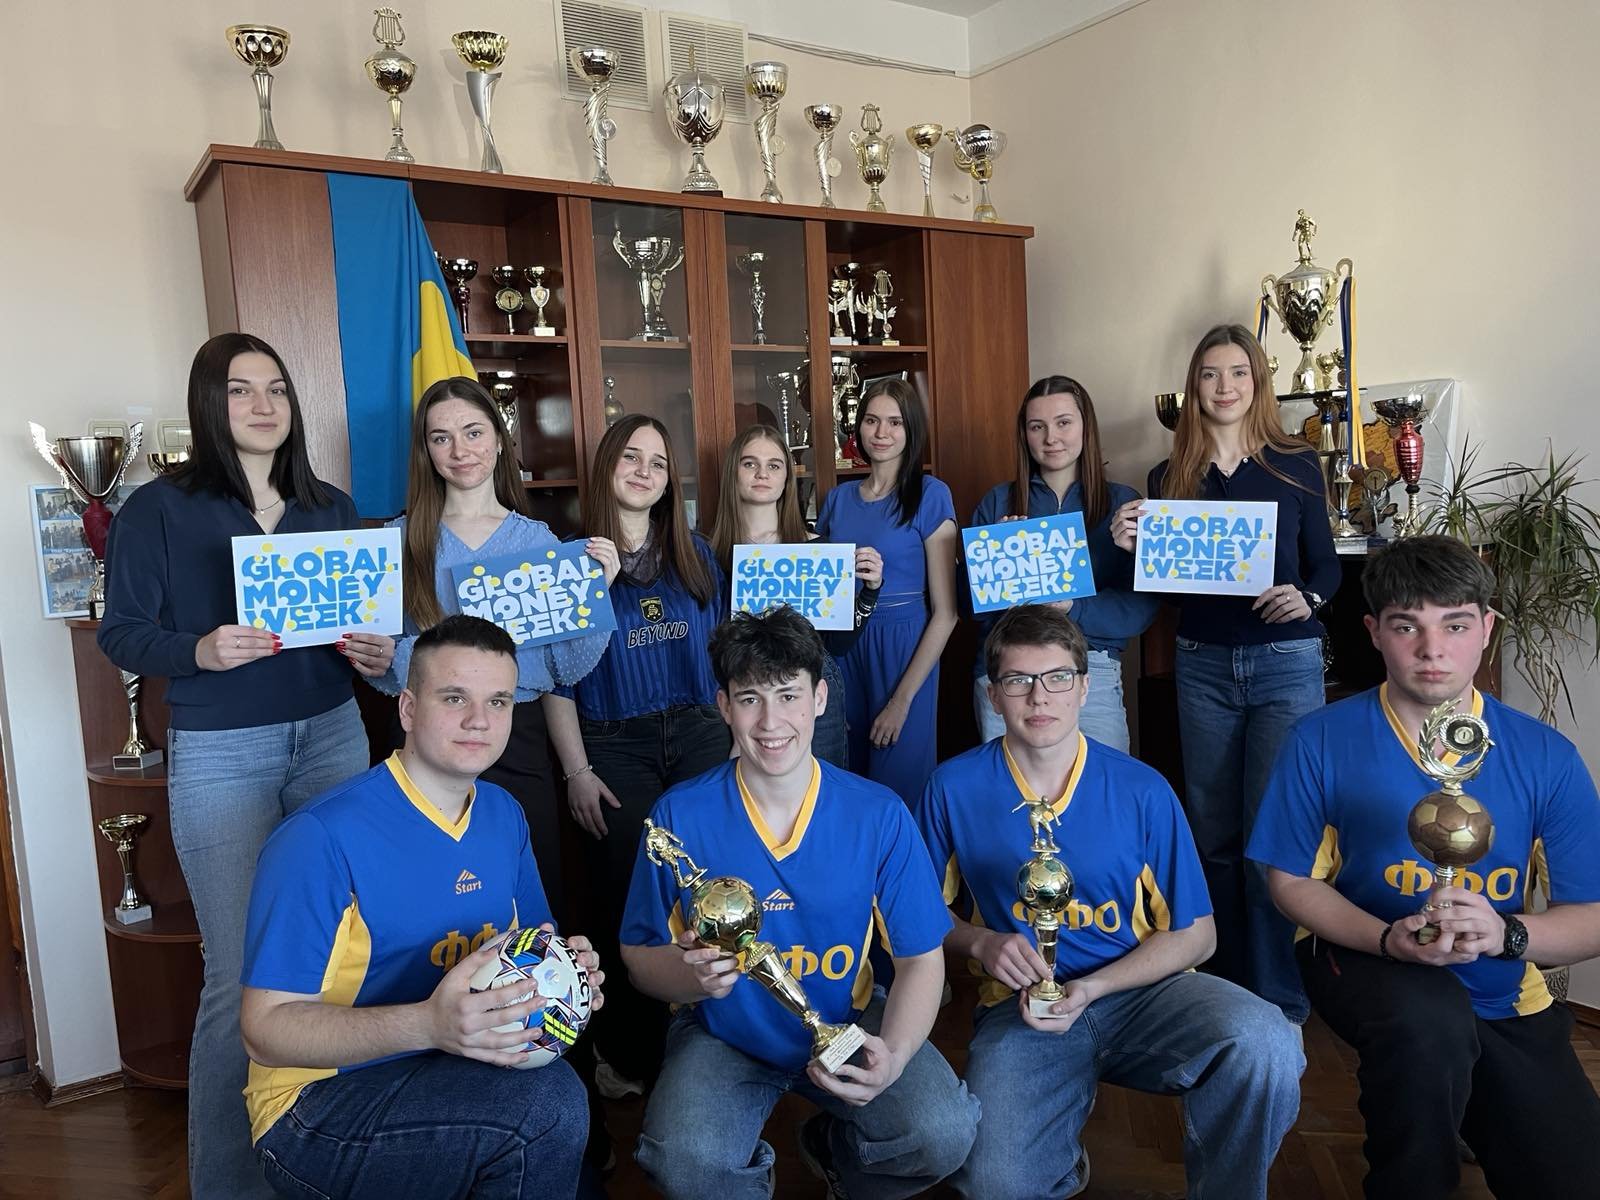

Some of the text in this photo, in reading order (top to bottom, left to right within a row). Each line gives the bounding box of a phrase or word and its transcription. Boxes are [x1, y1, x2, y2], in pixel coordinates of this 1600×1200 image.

[1142, 515, 1273, 540] GLOBAL
[966, 527, 1088, 563] GLOBAL
[1141, 537, 1260, 561] MONEY
[242, 547, 399, 582] GLOBAL
[458, 556, 604, 603] GLOBAL
[737, 558, 853, 578] GLOBAL
[969, 548, 1077, 585] MONEY
[1140, 558, 1237, 582] WEEK
[243, 573, 386, 610] MONEY
[736, 578, 841, 598] MONEY
[971, 572, 1063, 605] WEEK
[244, 600, 364, 634] WEEK
[495, 607, 580, 642] EEK
[627, 621, 689, 649] BEYOND
[455, 880, 482, 895] Start
[761, 901, 795, 912] Start
[736, 944, 855, 982] ФО
